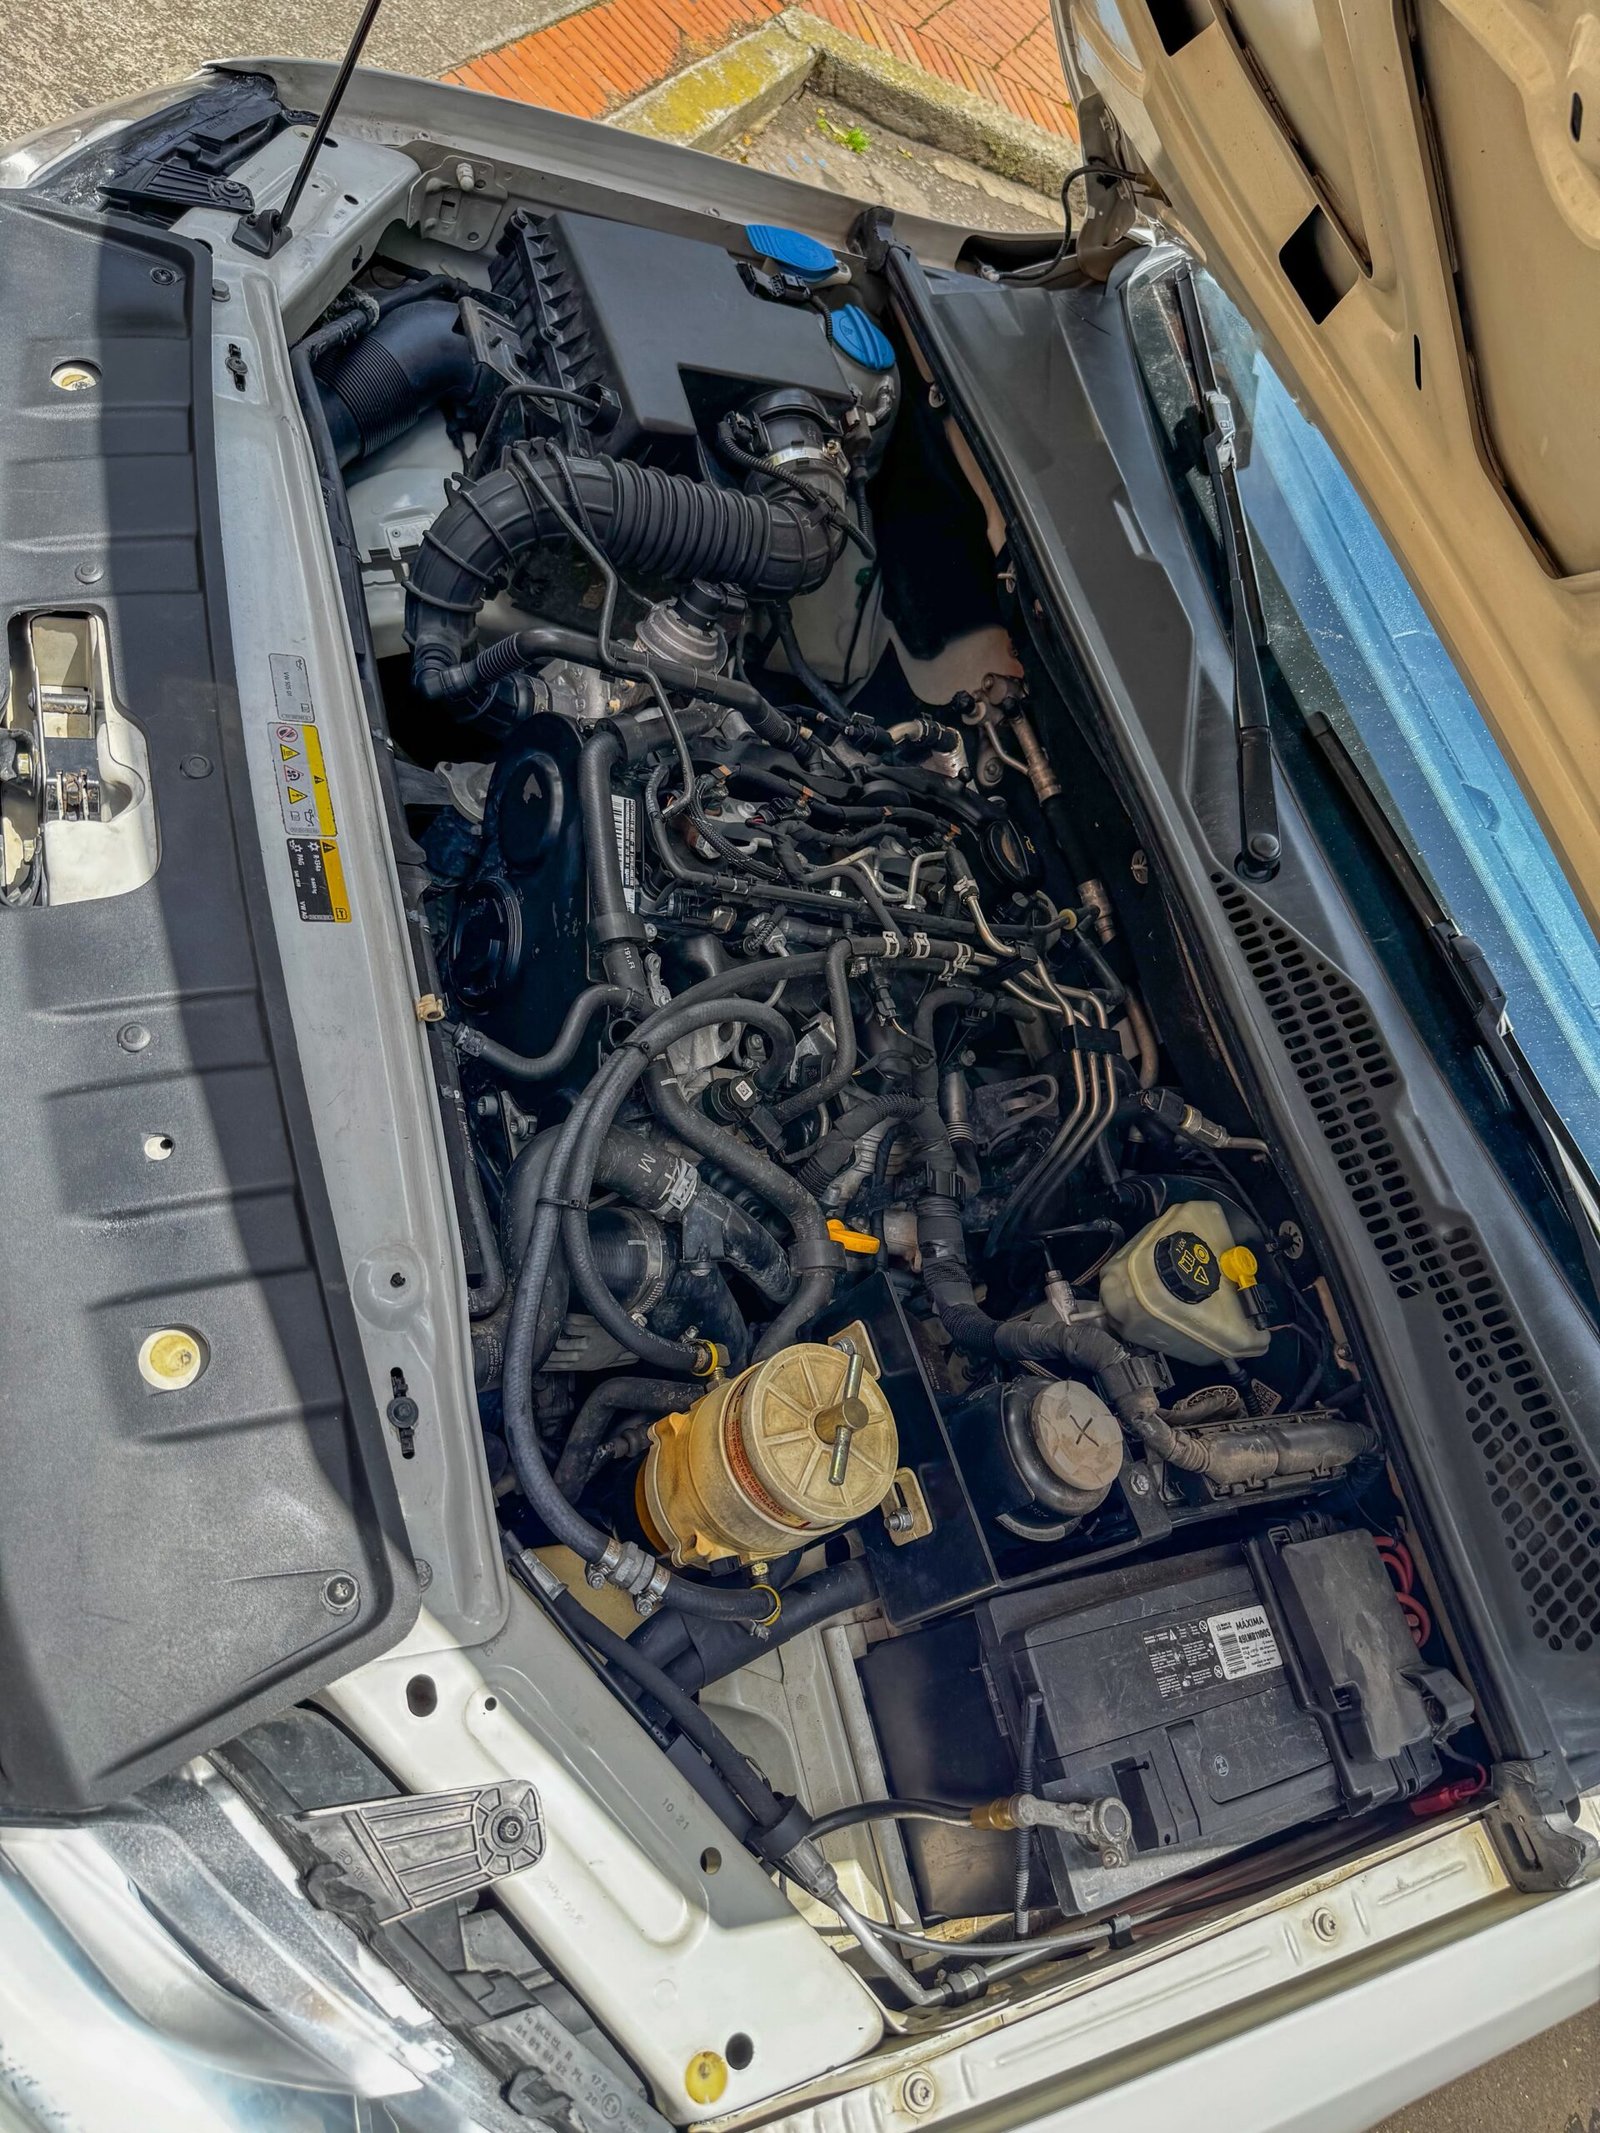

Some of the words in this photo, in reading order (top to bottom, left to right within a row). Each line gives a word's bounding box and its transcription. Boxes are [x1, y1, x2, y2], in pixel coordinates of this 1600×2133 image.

[297, 854, 305, 866] PAG
[750, 1476, 768, 1500] DIESEL
[748, 1480, 783, 1517] SEPARATOR
[1235, 1616, 1264, 1630] MÁXIMA
